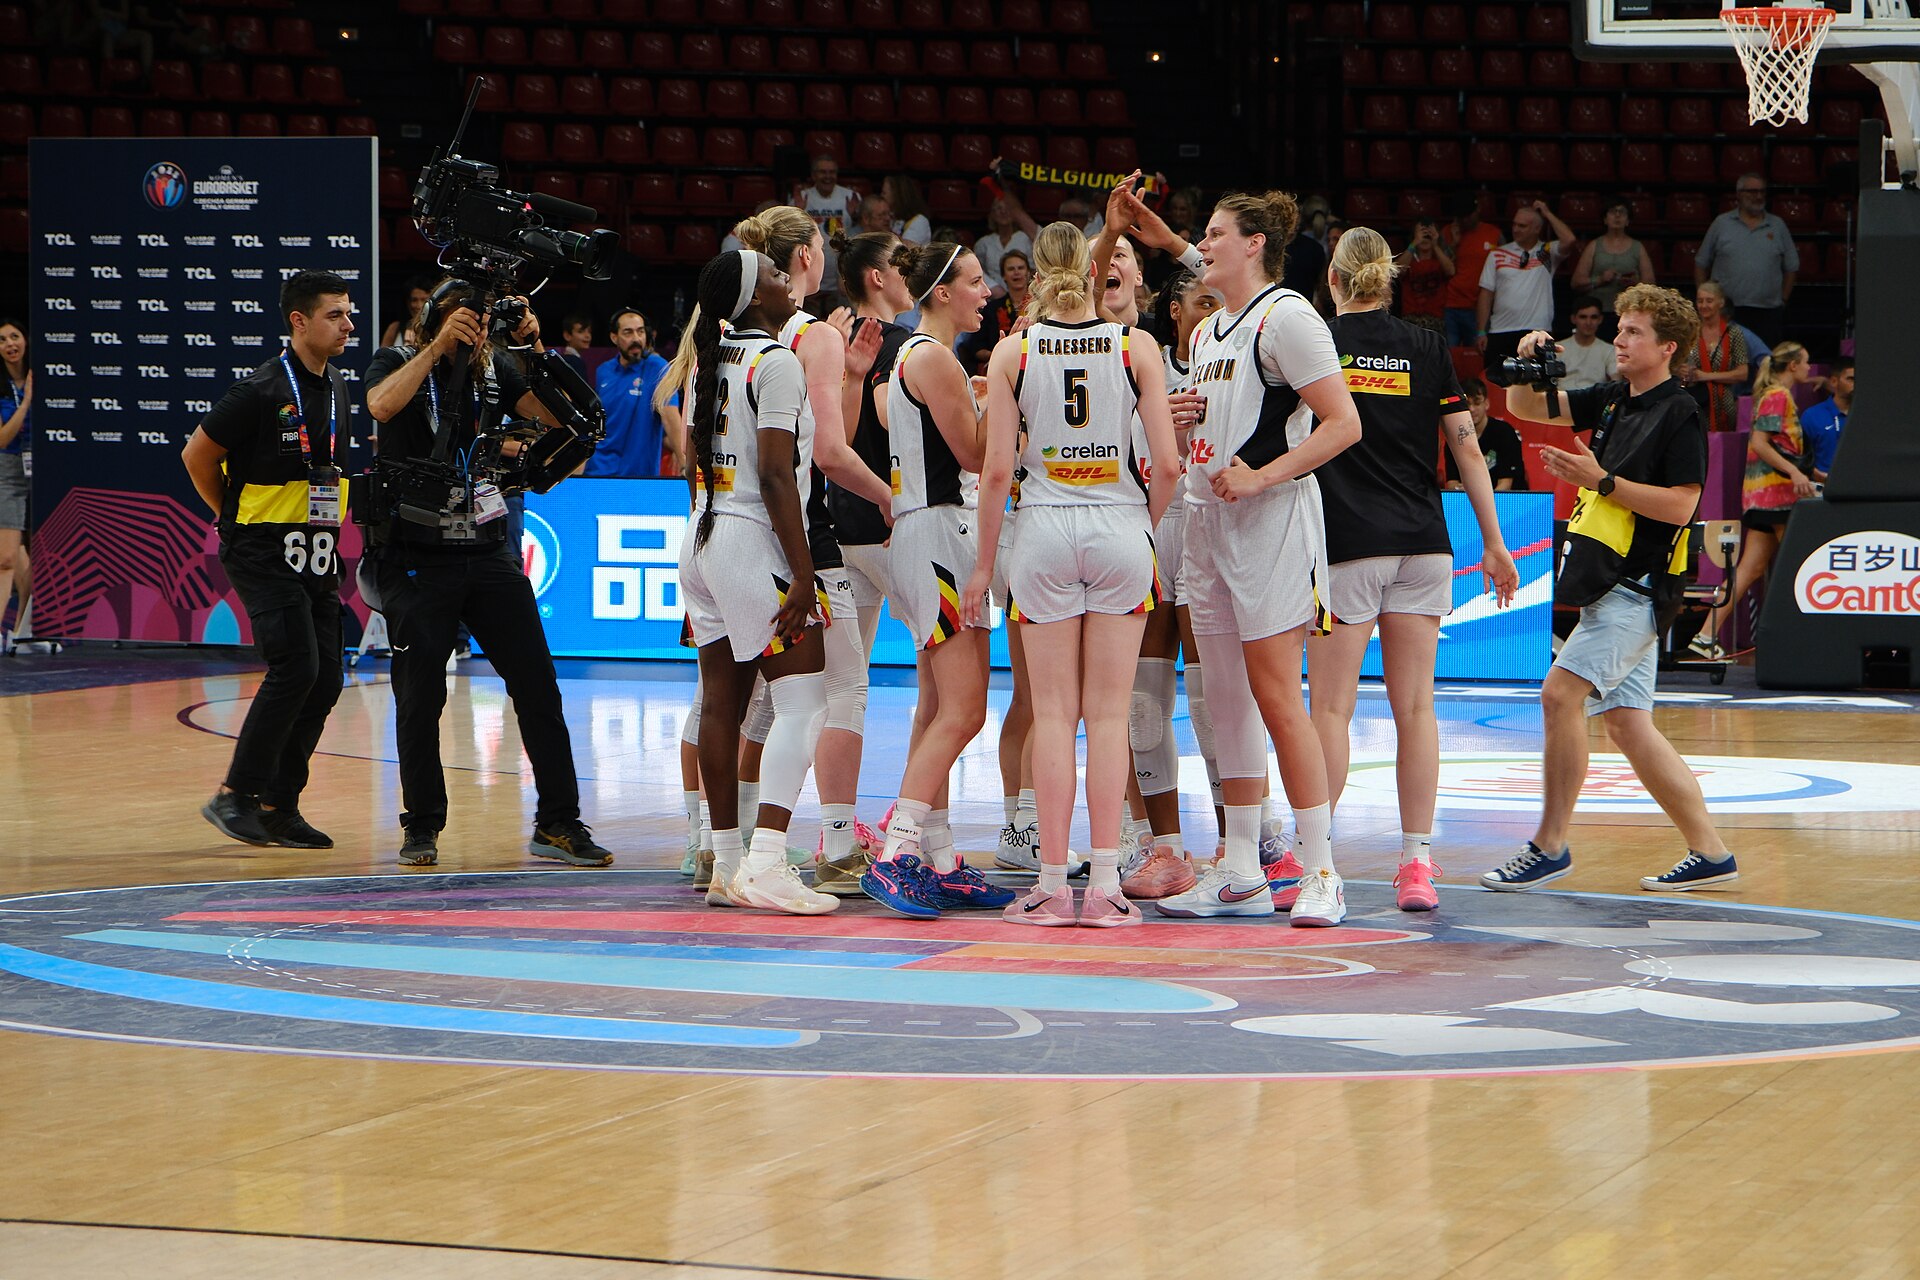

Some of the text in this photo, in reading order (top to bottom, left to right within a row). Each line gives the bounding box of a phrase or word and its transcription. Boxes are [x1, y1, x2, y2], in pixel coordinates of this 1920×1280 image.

[1019, 161, 1125, 190] BELGIUM
[193, 181, 259, 195] EUROBASKET
[45, 234, 75, 245] TCL
[138, 235, 169, 246] TCL
[232, 235, 263, 247] TCL
[328, 236, 360, 248] TCL
[91, 266, 121, 278] TCL
[184, 267, 216, 279] TCL
[45, 298, 75, 310] TCL
[138, 299, 169, 311] TCL
[232, 301, 263, 313] TCL
[91, 333, 122, 344] TCL
[184, 334, 216, 346] TCL
[1356, 354, 1411, 371] crelan
[45, 364, 75, 376] TCL
[138, 366, 169, 377] TCL
[1349, 374, 1399, 389] DHL
[91, 398, 122, 410] TCL
[1063, 368, 1089, 429] 5
[46, 430, 76, 441] TCL
[138, 432, 169, 444] TCL
[282, 432, 299, 442] FIBA
[1061, 442, 1118, 458] crelan
[1053, 466, 1107, 480] DHL
